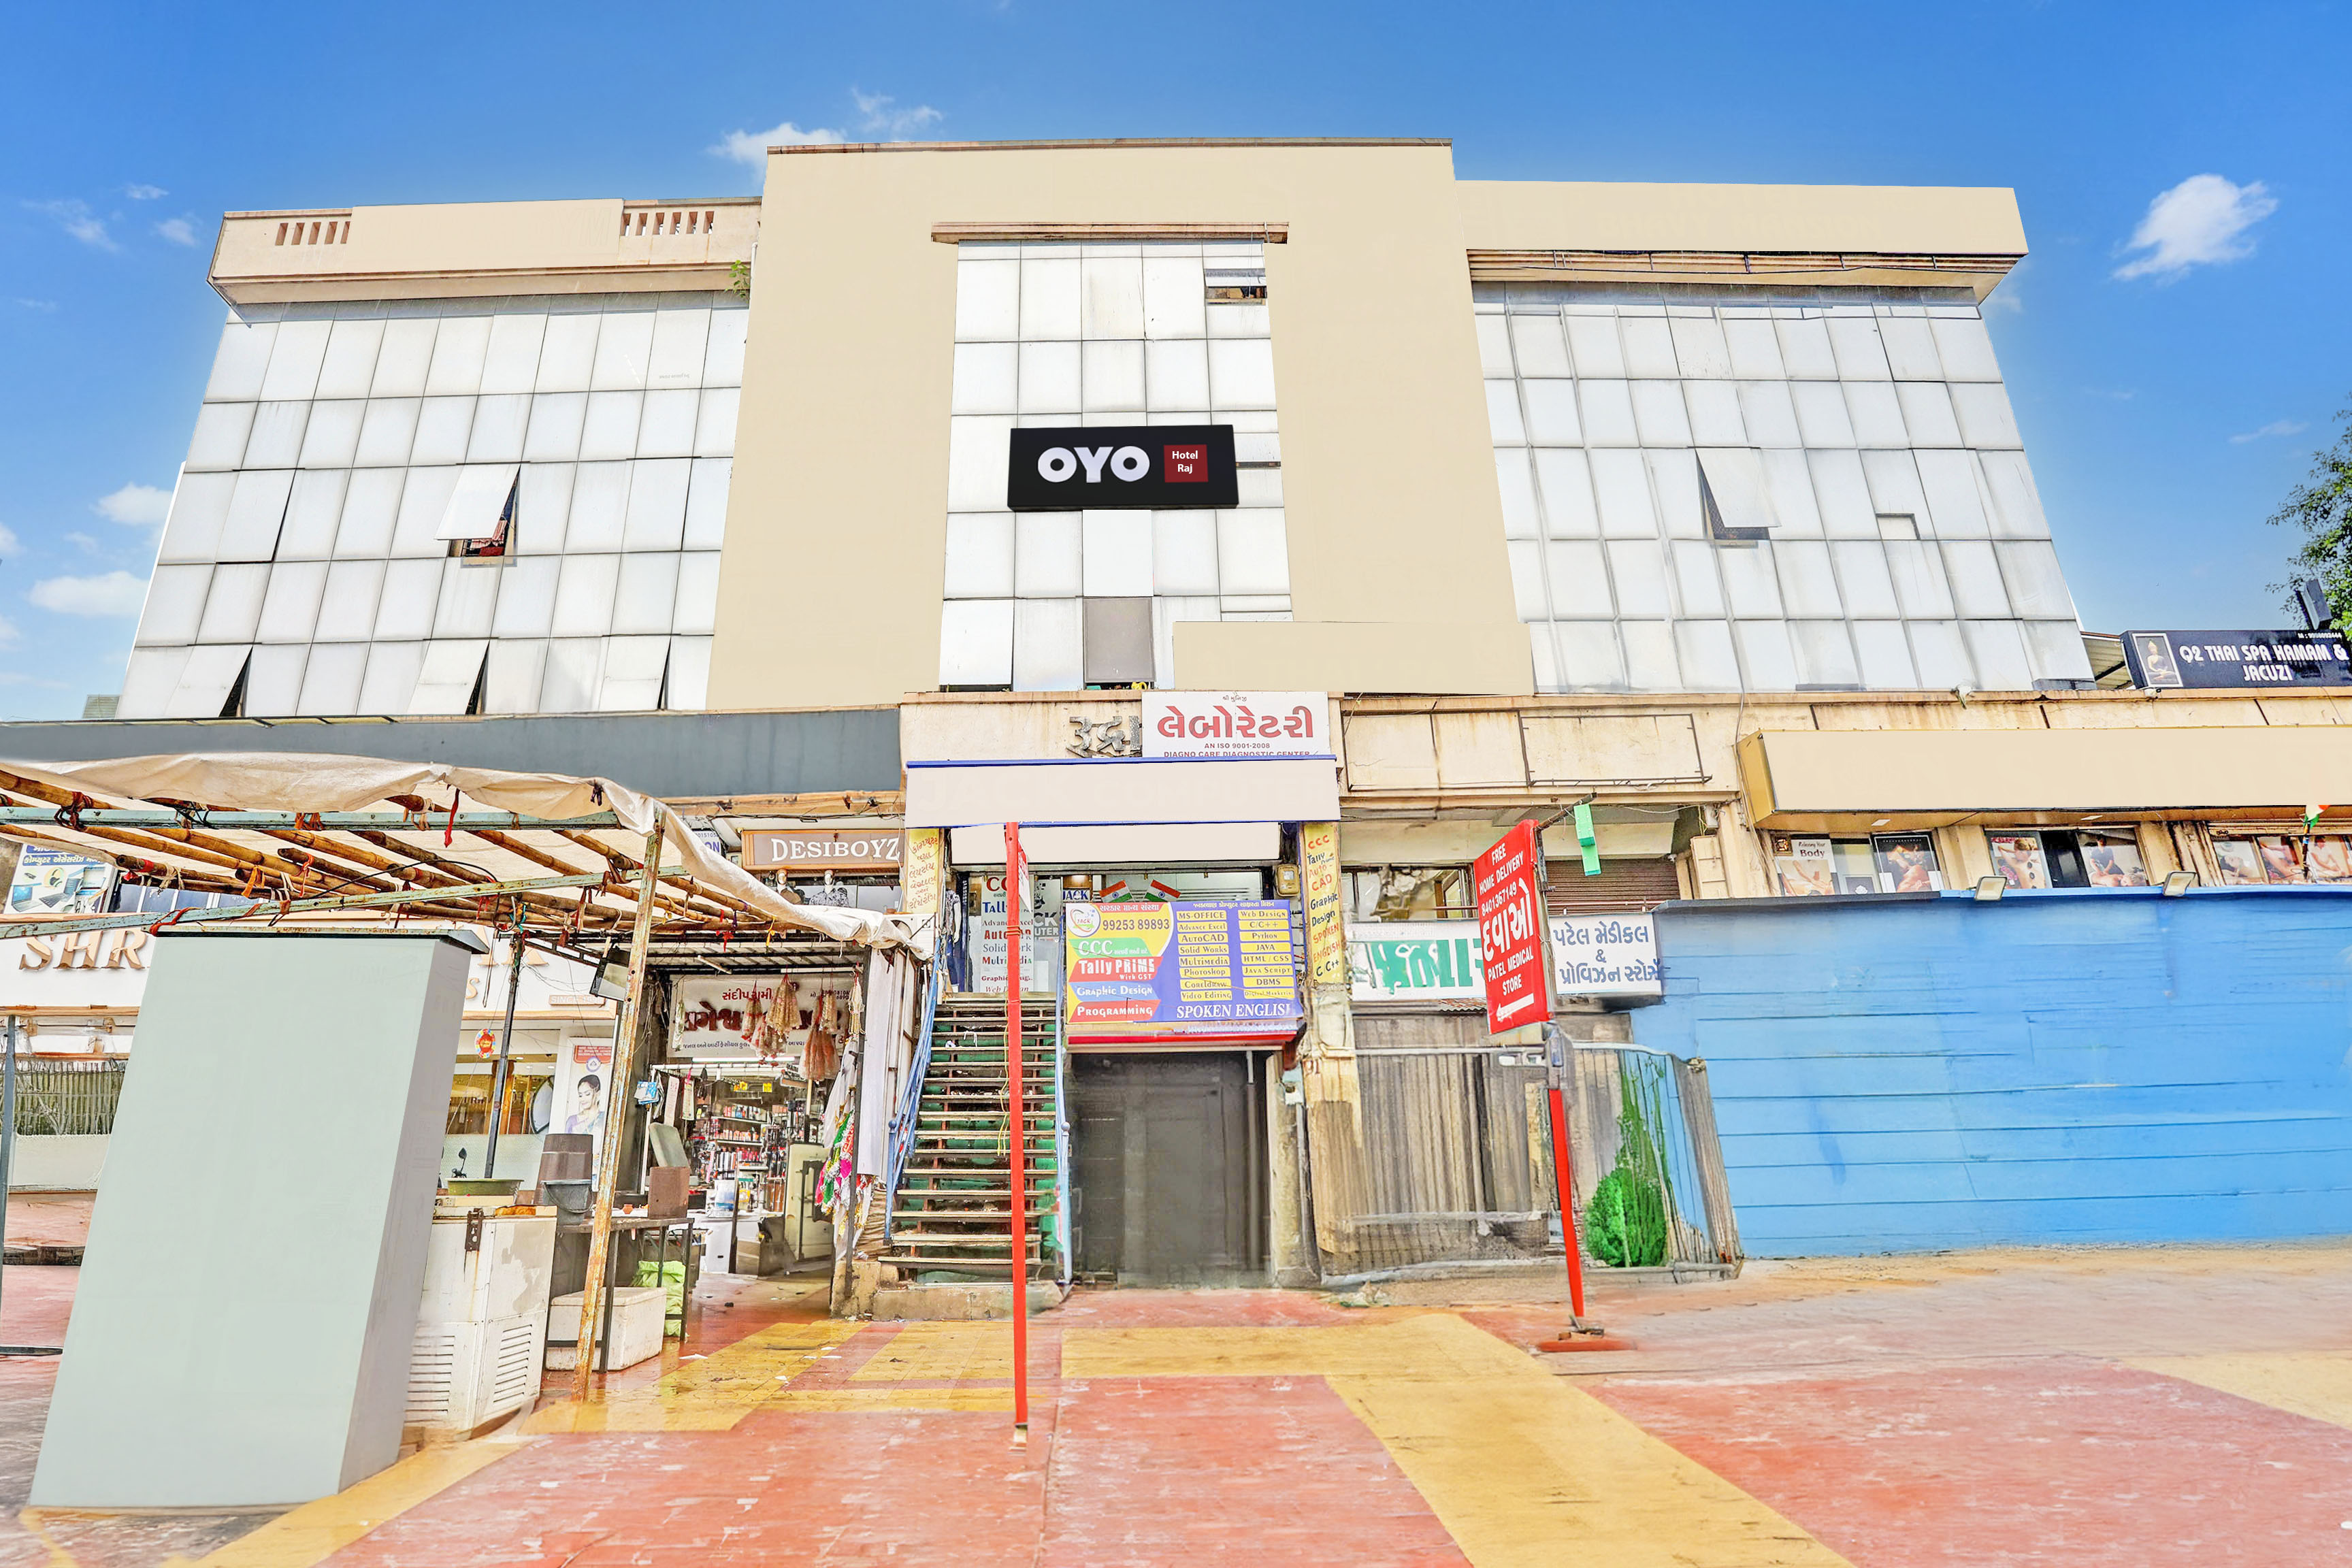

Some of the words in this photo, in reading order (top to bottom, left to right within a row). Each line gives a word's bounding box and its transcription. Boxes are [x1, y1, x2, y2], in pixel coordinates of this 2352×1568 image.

[1172, 450, 1198, 459] Hotel
[1037, 446, 1151, 483] OYO
[1177, 464, 1193, 474] Raj
[2204, 645, 2241, 662] THAI
[2242, 645, 2274, 662] SPA
[2272, 644, 2332, 661] HAMAM
[2333, 644, 2349, 660] &
[2243, 664, 2293, 681] JACUZI
[1158, 705, 1313, 738] લેબોરેટરી
[771, 837, 900, 862] DESIBOYZ
[1308, 835, 1330, 849] CCC
[1307, 852, 1325, 865] Tally
[1491, 843, 1506, 866] FREE
[1800, 849, 1825, 859] Body
[1480, 874, 1495, 895] HOME
[1496, 851, 1523, 883] DELIVERY
[1311, 874, 1332, 891] CAD
[1063, 890, 1089, 900] JACK
[1482, 881, 1517, 917] 8401367149
[982, 901, 1007, 913] Tall
[1103, 919, 1134, 930] 99253
[1138, 919, 1169, 930] 89893
[1312, 911, 1335, 926] Design
[1482, 877, 1534, 962] દવાઓ
[1034, 928, 1059, 936] UTER
[1181, 934, 1224, 943] AutoCAD
[1313, 922, 1339, 944] SPOKEN
[1553, 921, 1590, 946] પટેલ
[1595, 921, 1649, 944] મેડીકલ
[18, 930, 150, 970] SHR
[1078, 941, 1113, 956] CCC
[1313, 939, 1341, 963] ENGLISH
[1595, 949, 1606, 963] &
[1079, 960, 1112, 975] Tally
[1115, 959, 1154, 973] PRIME
[1180, 957, 1228, 966] Multimedia
[1316, 966, 1323, 977] C
[1326, 959, 1339, 971] C++
[1488, 962, 1506, 982] PATEL
[1507, 945, 1534, 973] MEDICAL
[1559, 961, 1621, 984] પ્રોવિઝન
[1077, 985, 1117, 997] Graphic
[1120, 985, 1153, 996] Design
[1503, 974, 1522, 996] STORE
[1205, 990, 1231, 999] Editing
[1077, 1004, 1153, 1017] Programming
[1177, 1004, 1232, 1019] SPOKEN
